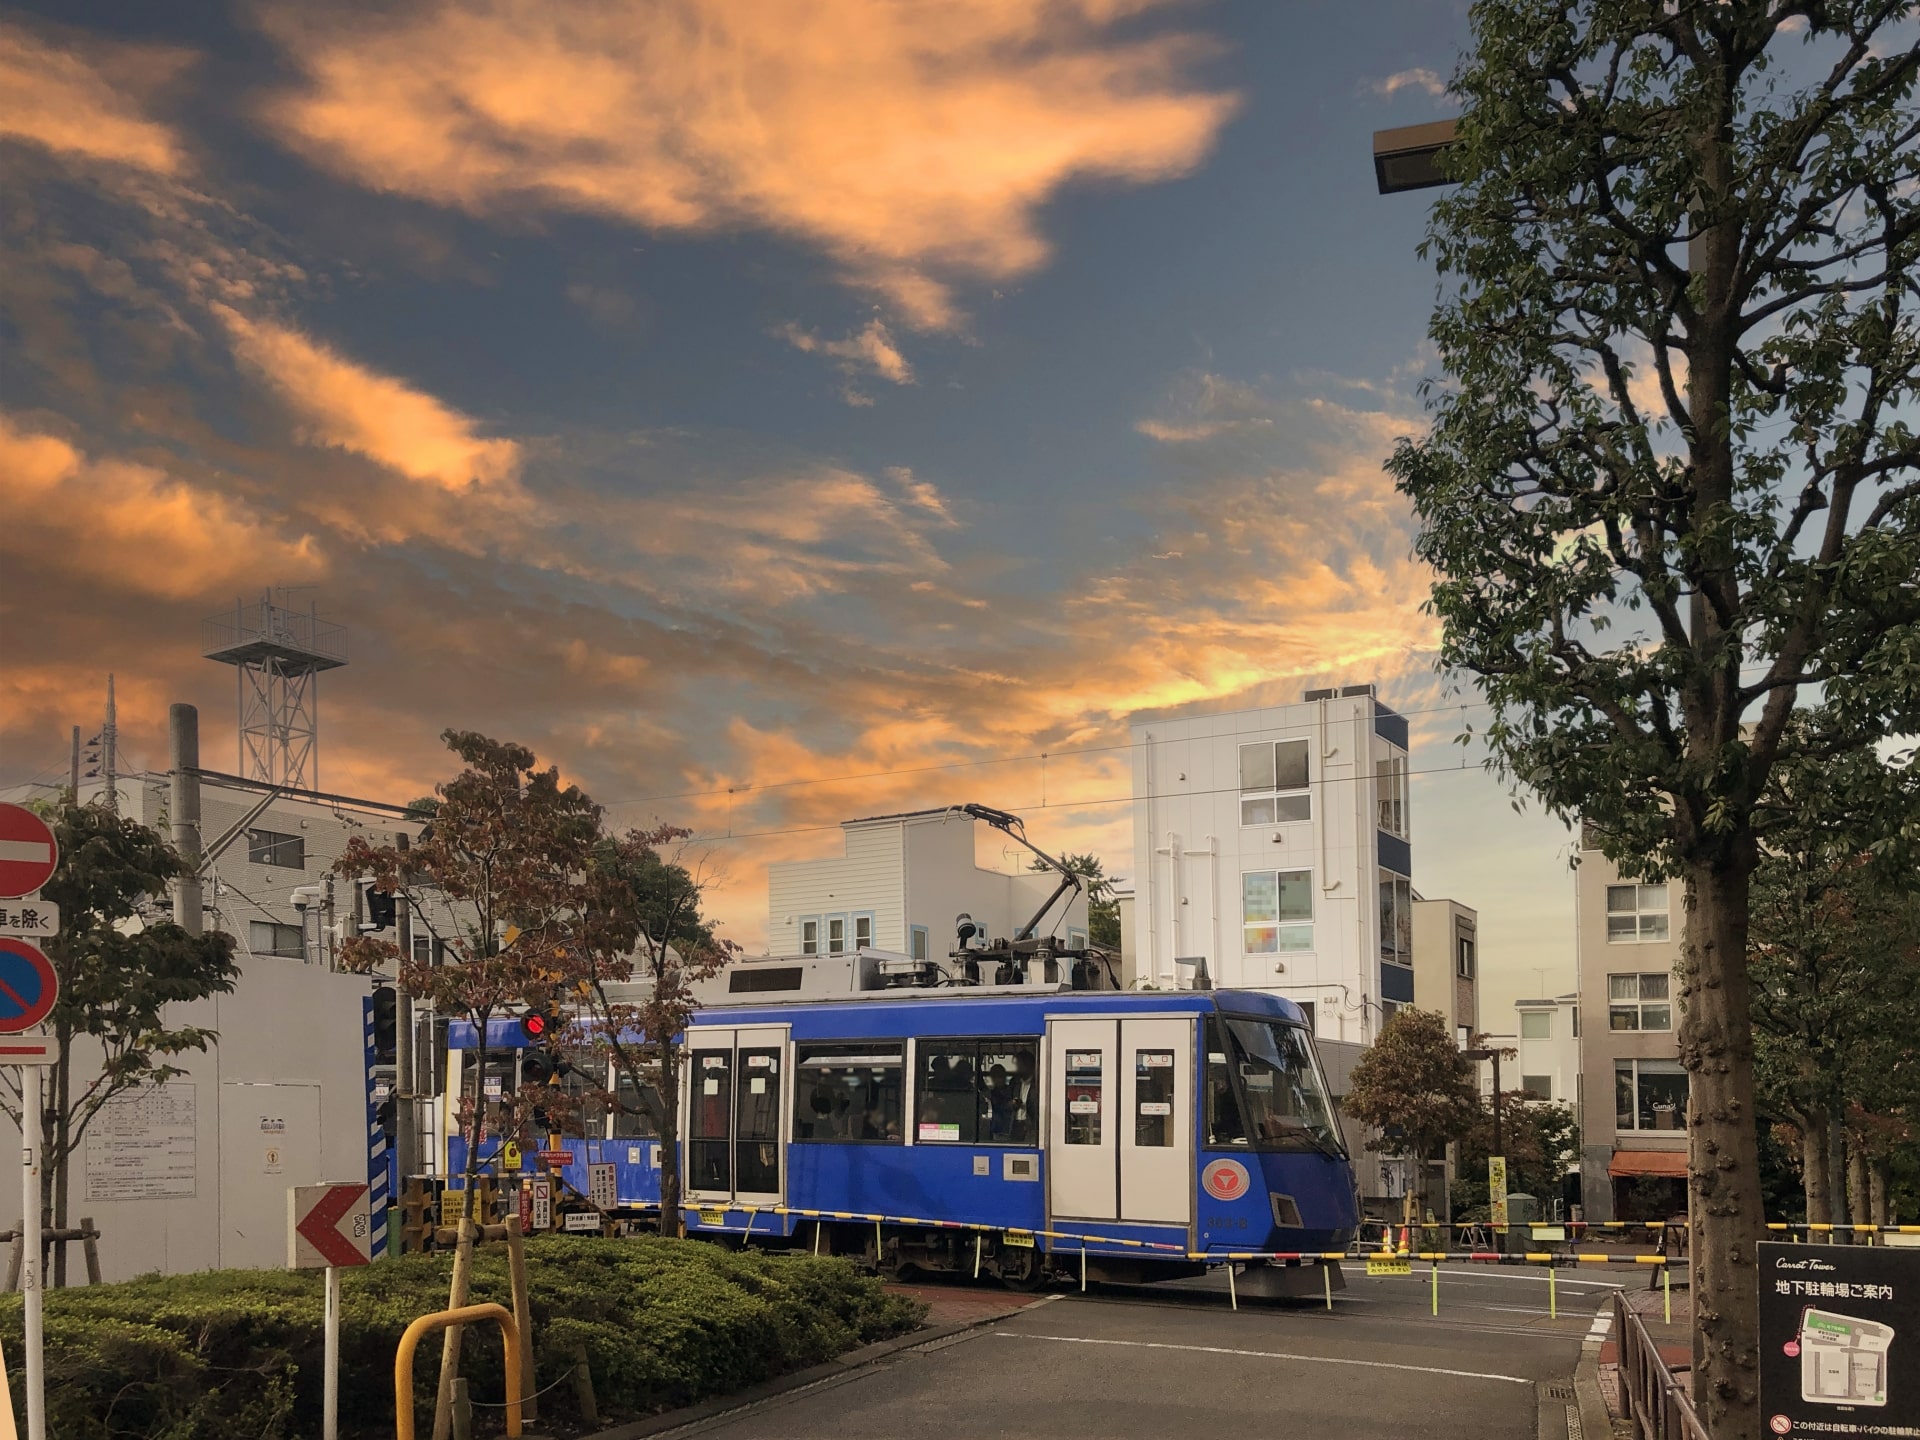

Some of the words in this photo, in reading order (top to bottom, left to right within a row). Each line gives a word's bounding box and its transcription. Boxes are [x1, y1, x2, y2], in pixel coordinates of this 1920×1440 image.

[1776, 1257, 1808, 1269] Carrot
[1809, 1259, 1837, 1270] Tower
[1775, 1279, 1893, 1300] 地下駐輪場ご案内
